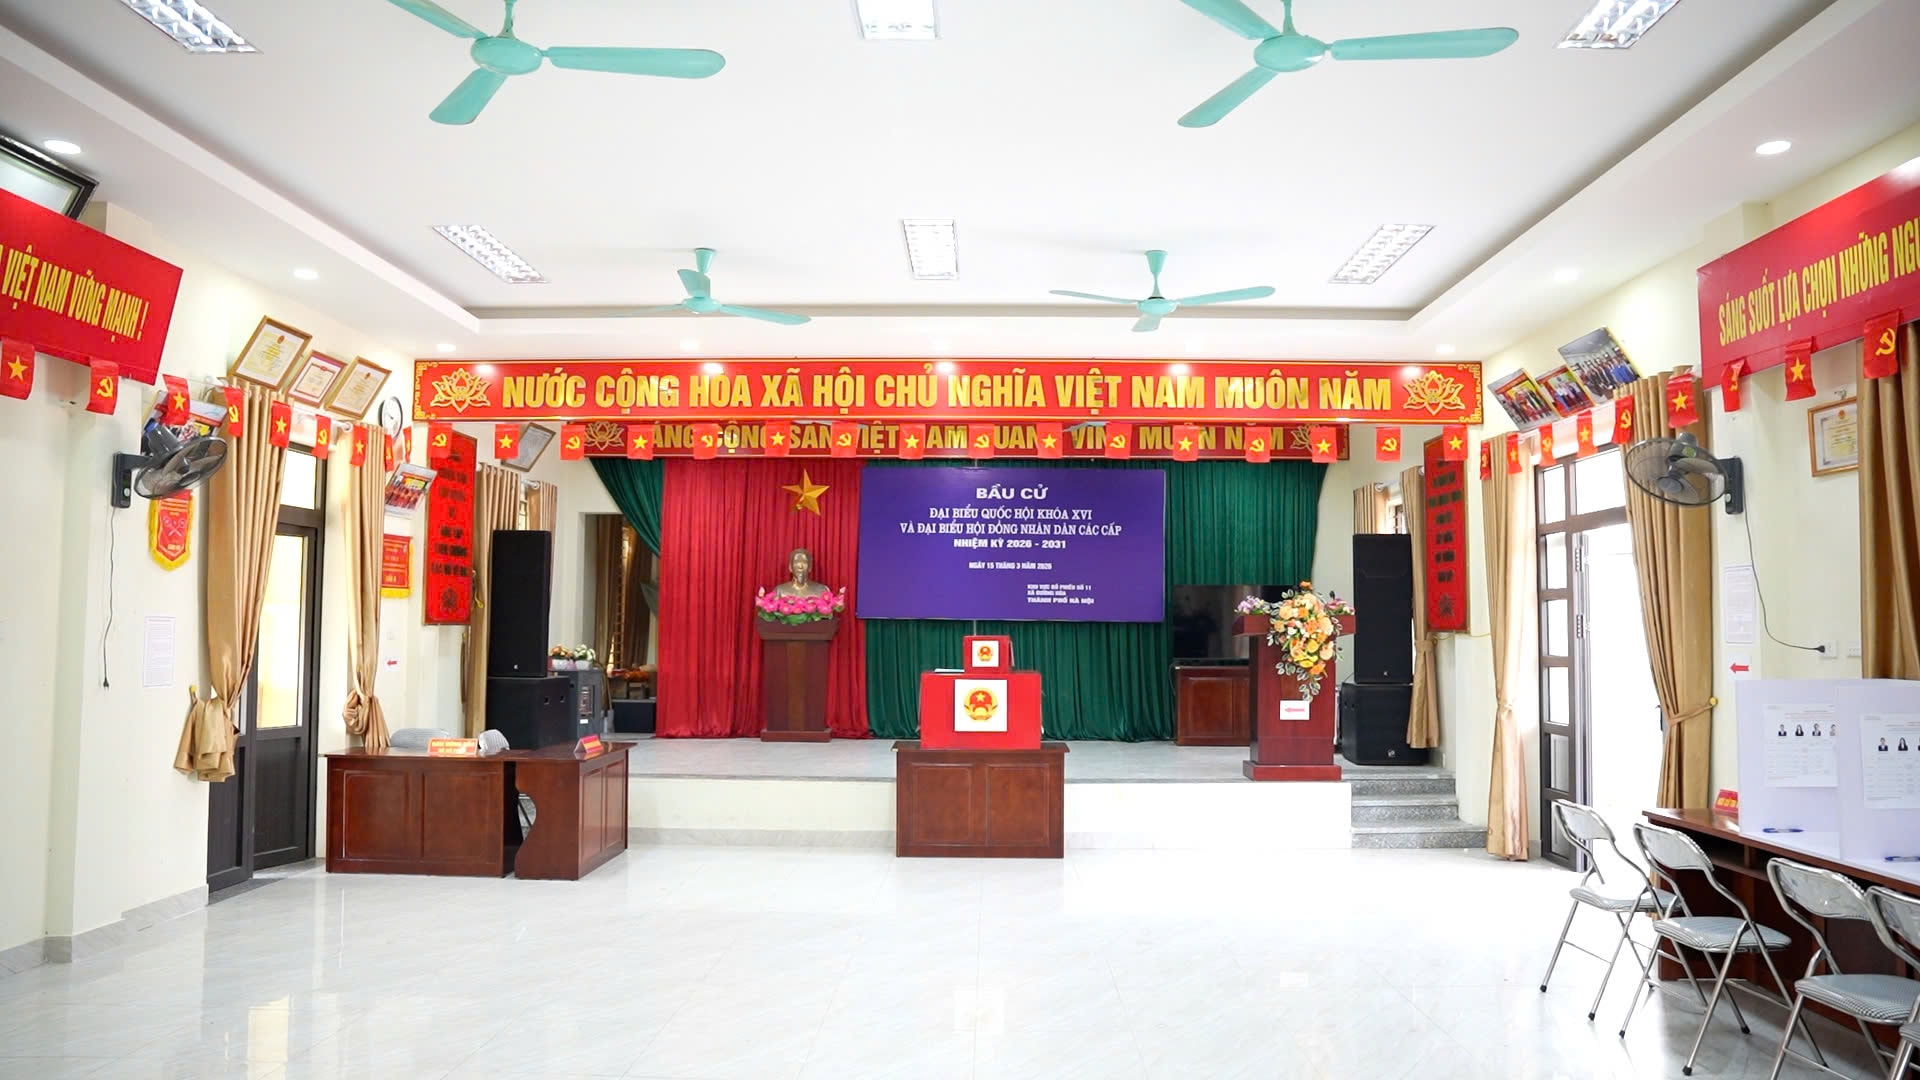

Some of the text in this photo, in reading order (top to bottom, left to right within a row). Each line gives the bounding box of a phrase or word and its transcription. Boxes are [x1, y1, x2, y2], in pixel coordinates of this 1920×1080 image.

[1, 244, 39, 310] VIỆT
[33, 261, 73, 315] NAM
[67, 269, 107, 327] VỮNG
[1719, 292, 1747, 346] SÁNG
[1748, 268, 1775, 335] SUỐT
[1777, 269, 1801, 331] LỰA
[1802, 255, 1838, 318] CHỌN
[1838, 231, 1890, 300] NHỮNG
[502, 367, 586, 409] NƯỚC
[595, 367, 680, 415] CỘNG
[760, 367, 804, 408] XÃ
[812, 366, 865, 415] HỘI
[875, 363, 938, 408] CHỦ
[947, 367, 1046, 408] NGHĨA
[1055, 367, 1123, 415] VIỆT
[1131, 374, 1205, 409] NAM
[1215, 368, 1309, 410] MUÔN
[1319, 370, 1392, 411] NĂM
[925, 425, 968, 449] AM
[976, 484, 1049, 500] BẦU CỬ
[929, 504, 1092, 521] ĐẠI BIỂU QUỐC HỘI KHÓA XVI
[900, 520, 915, 533] VÀ
[917, 522, 936, 535] ĐẠI
[938, 519, 964, 534] BIỂU
[966, 522, 985, 535] HỘI
[1078, 523, 1100, 536] CÁC
[1101, 522, 1122, 536] CẤP
[953, 537, 989, 550] NHIỆM
[990, 537, 1004, 548] KỲ
[1006, 539, 1033, 549] 2026
[1041, 539, 1066, 549] 2031
[986, 561, 995, 570] 15
